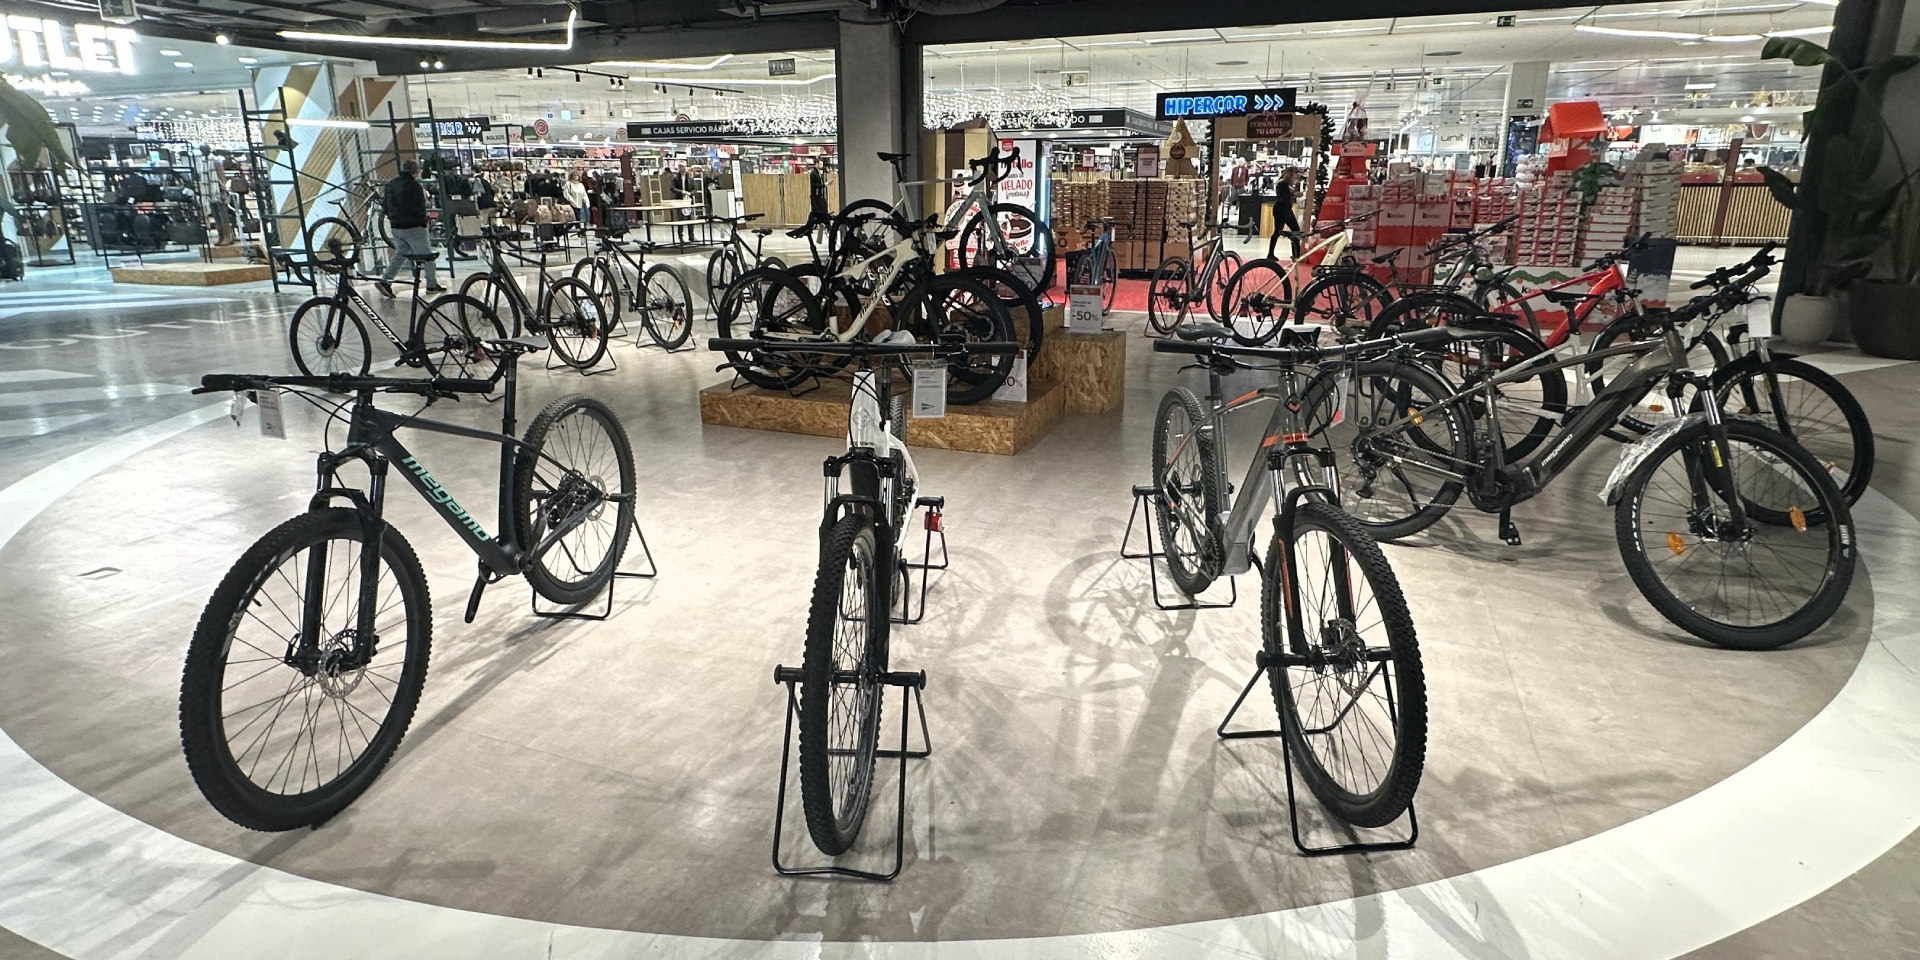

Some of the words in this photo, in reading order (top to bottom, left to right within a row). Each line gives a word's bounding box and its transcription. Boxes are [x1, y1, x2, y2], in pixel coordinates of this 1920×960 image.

[1165, 95, 1247, 115] HIPERCOR
[653, 127, 675, 135] CAJAS
[1440, 133, 1465, 142] unit
[1001, 179, 1033, 192] HELADO
[1072, 310, 1099, 321] -50%
[402, 455, 490, 541] megamo
